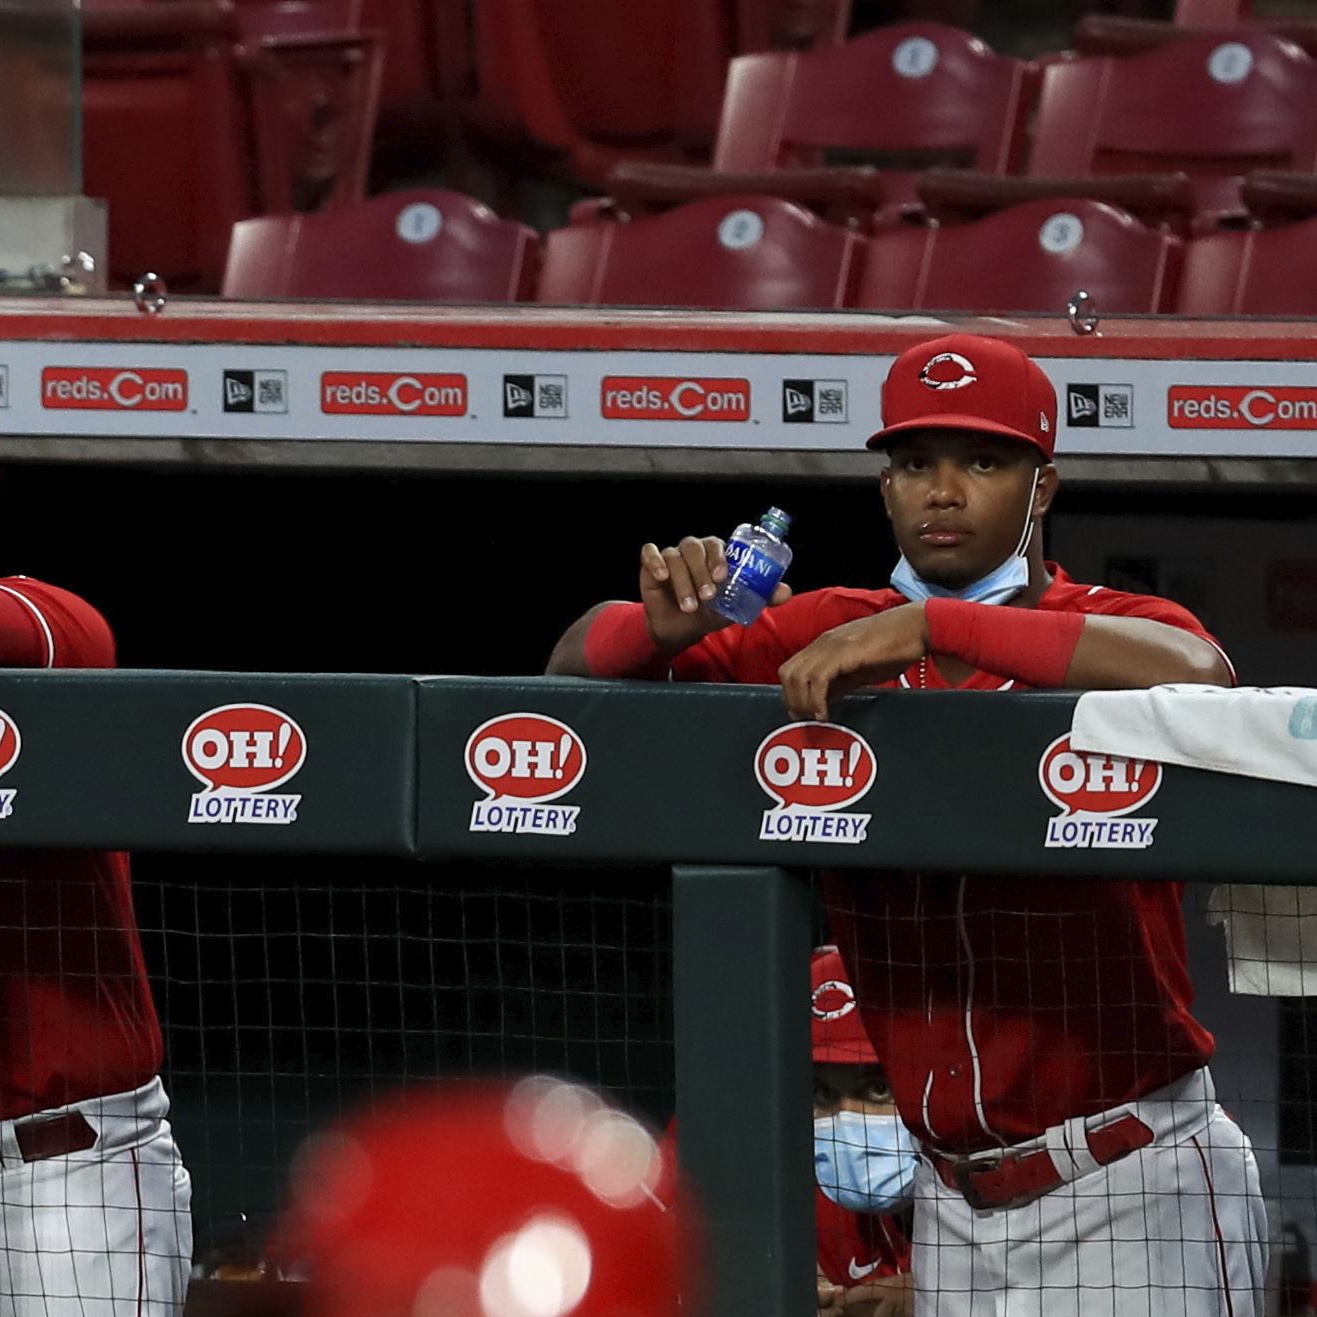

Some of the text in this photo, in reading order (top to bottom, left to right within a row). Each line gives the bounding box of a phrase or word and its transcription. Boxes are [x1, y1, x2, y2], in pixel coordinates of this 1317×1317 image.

[819, 401, 843, 413] ERA
[1104, 406, 1128, 418] ERA
[192, 722, 292, 770] OH!
[474, 733, 572, 779] OH!
[764, 741, 861, 787] OH!
[193, 797, 294, 818] LOTTERY
[474, 806, 574, 829] LOTTERY
[764, 815, 864, 837] LOTTERY
[1050, 822, 1150, 842] LOTTERY
